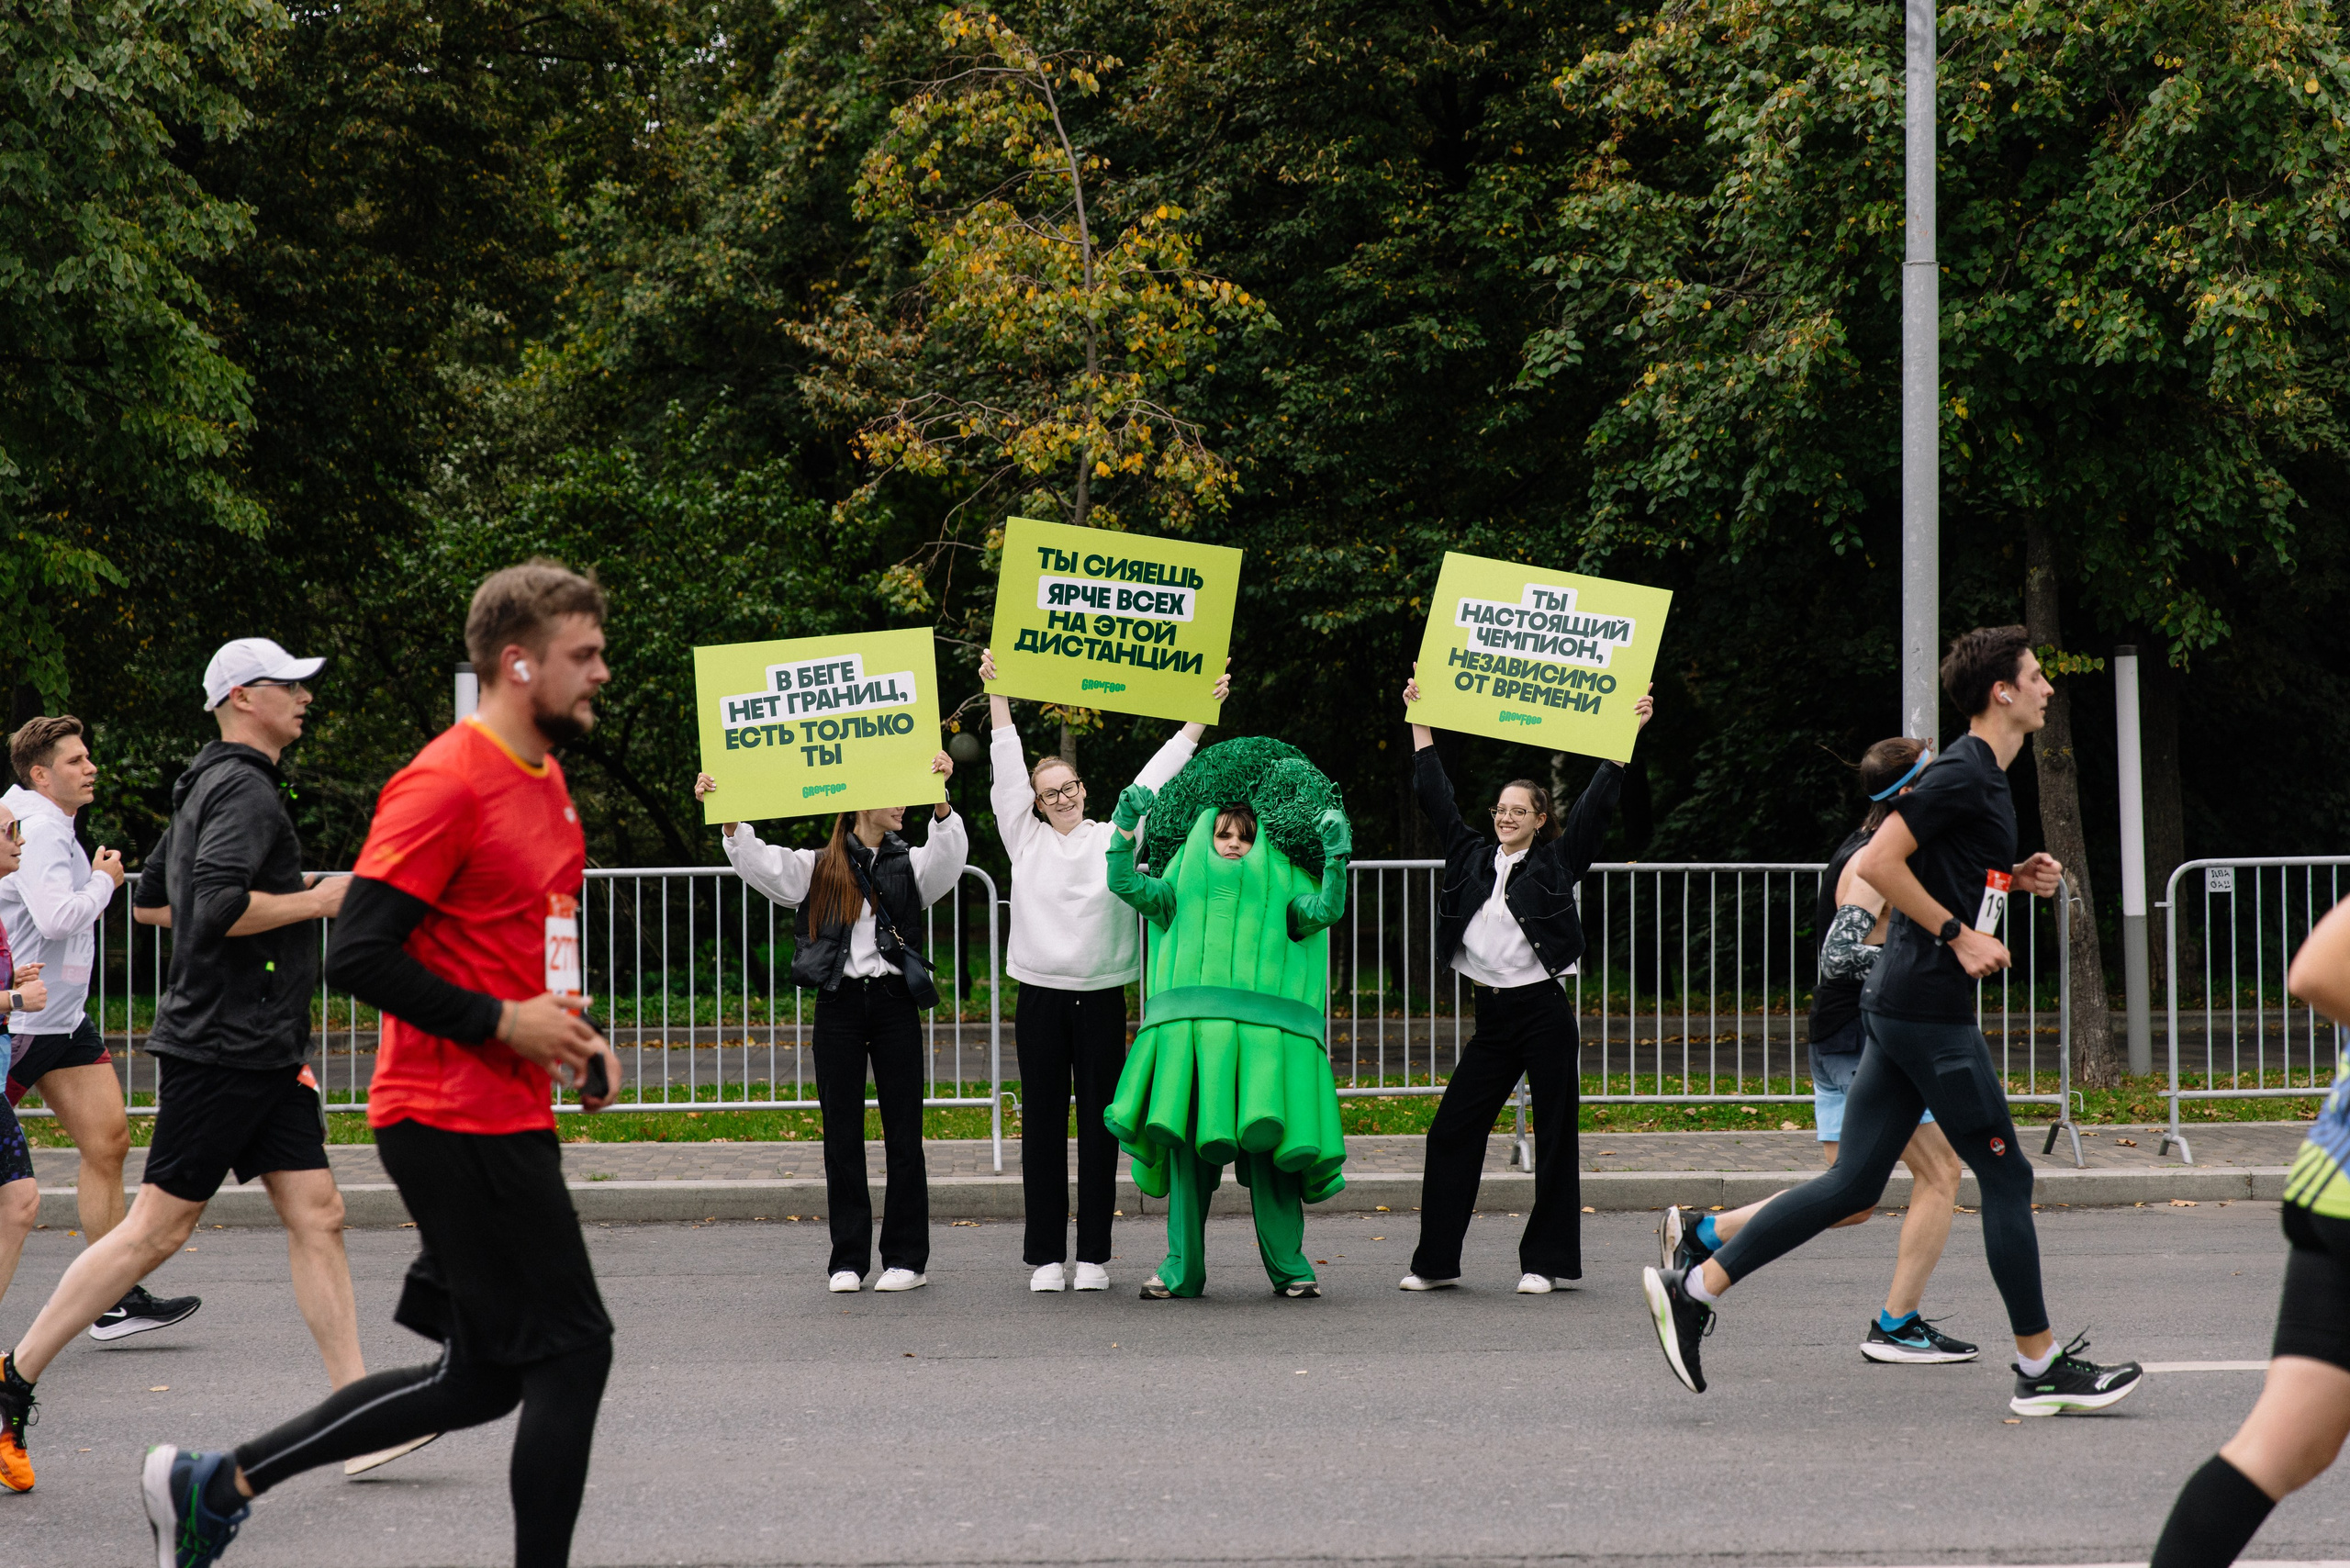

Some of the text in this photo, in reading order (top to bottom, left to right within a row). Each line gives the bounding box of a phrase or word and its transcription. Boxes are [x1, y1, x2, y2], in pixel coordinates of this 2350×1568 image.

[1037, 546, 1204, 590] ТЫ СИЯЕШЬ
[1046, 583, 1186, 615] ЯРЧЕ ВСЕХ
[1532, 589, 1568, 611] ТЫ
[1047, 610, 1177, 646] НА ЭТОЙ
[1460, 603, 1630, 642] НАСТОЯЩИЙ
[1013, 628, 1203, 675] ДИСТАНЦИИ
[1476, 627, 1604, 664] ЧЕМПИОН,
[776, 660, 855, 692] В БЕГЕ
[1448, 647, 1617, 694] НЕЗАВИСИМО
[728, 678, 908, 722] НЕТ ГРАНИЦ,
[1454, 671, 1602, 715] ОТ ВРЕМЕНИ
[724, 712, 914, 750] ЕСТЬ ТОЛЬКО
[800, 743, 843, 767] ТЫ
[1986, 894, 2003, 920] 19
